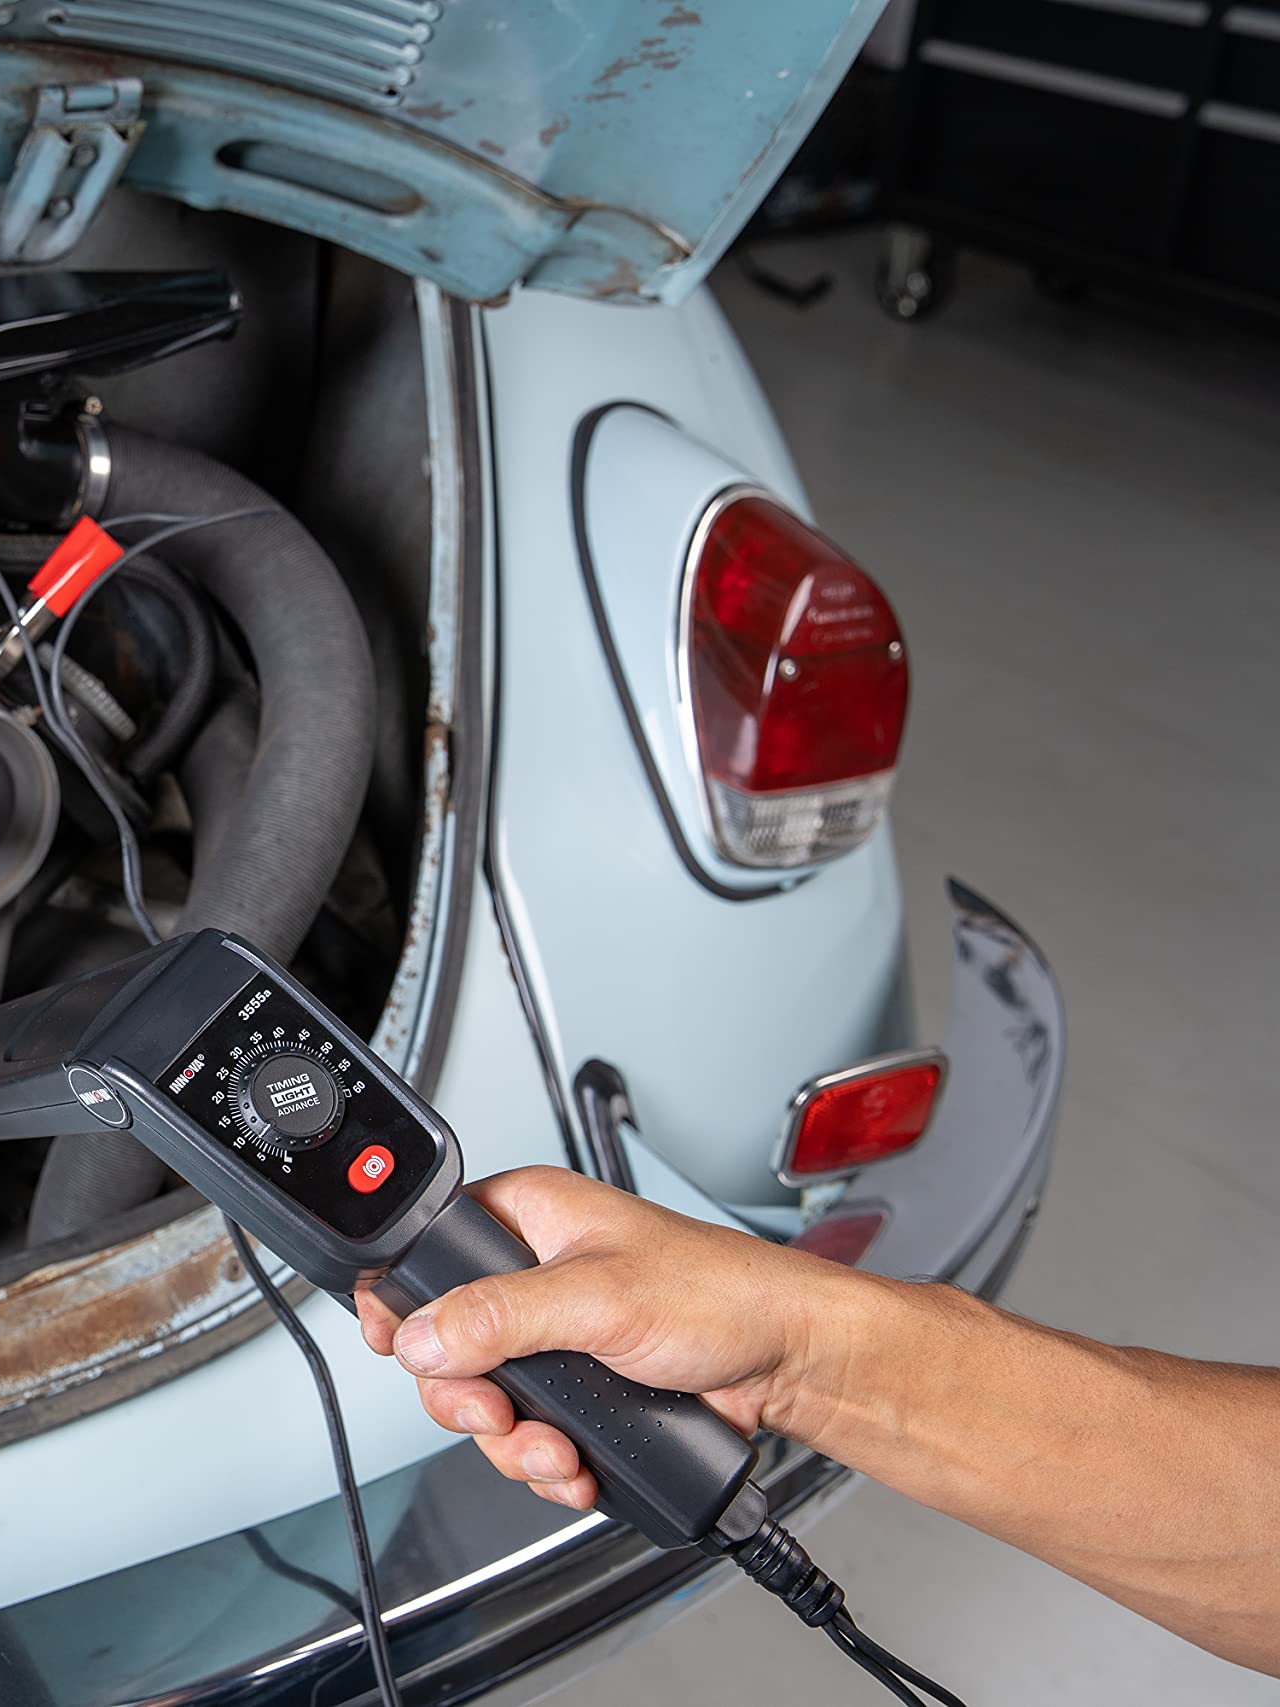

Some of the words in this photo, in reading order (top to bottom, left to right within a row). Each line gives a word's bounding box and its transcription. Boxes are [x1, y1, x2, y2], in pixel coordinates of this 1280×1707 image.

[238, 989, 272, 1021] 3555a
[250, 1031, 263, 1045] 35
[272, 1026, 285, 1039] 40
[297, 1029, 311, 1042] 45
[230, 1046, 243, 1060] 30
[319, 1041, 334, 1055] 50
[337, 1058, 351, 1072] 55
[216, 1066, 230, 1081] 25
[266, 1073, 310, 1093] TIMING
[352, 1080, 366, 1094] 60
[211, 1091, 225, 1105] 20
[274, 1085, 312, 1105] LIGHT
[277, 1096, 321, 1117] ADVANCE
[218, 1116, 232, 1129] 15
[233, 1136, 246, 1149] 10
[256, 1151, 267, 1162] 5
[281, 1164, 292, 1174] 0
